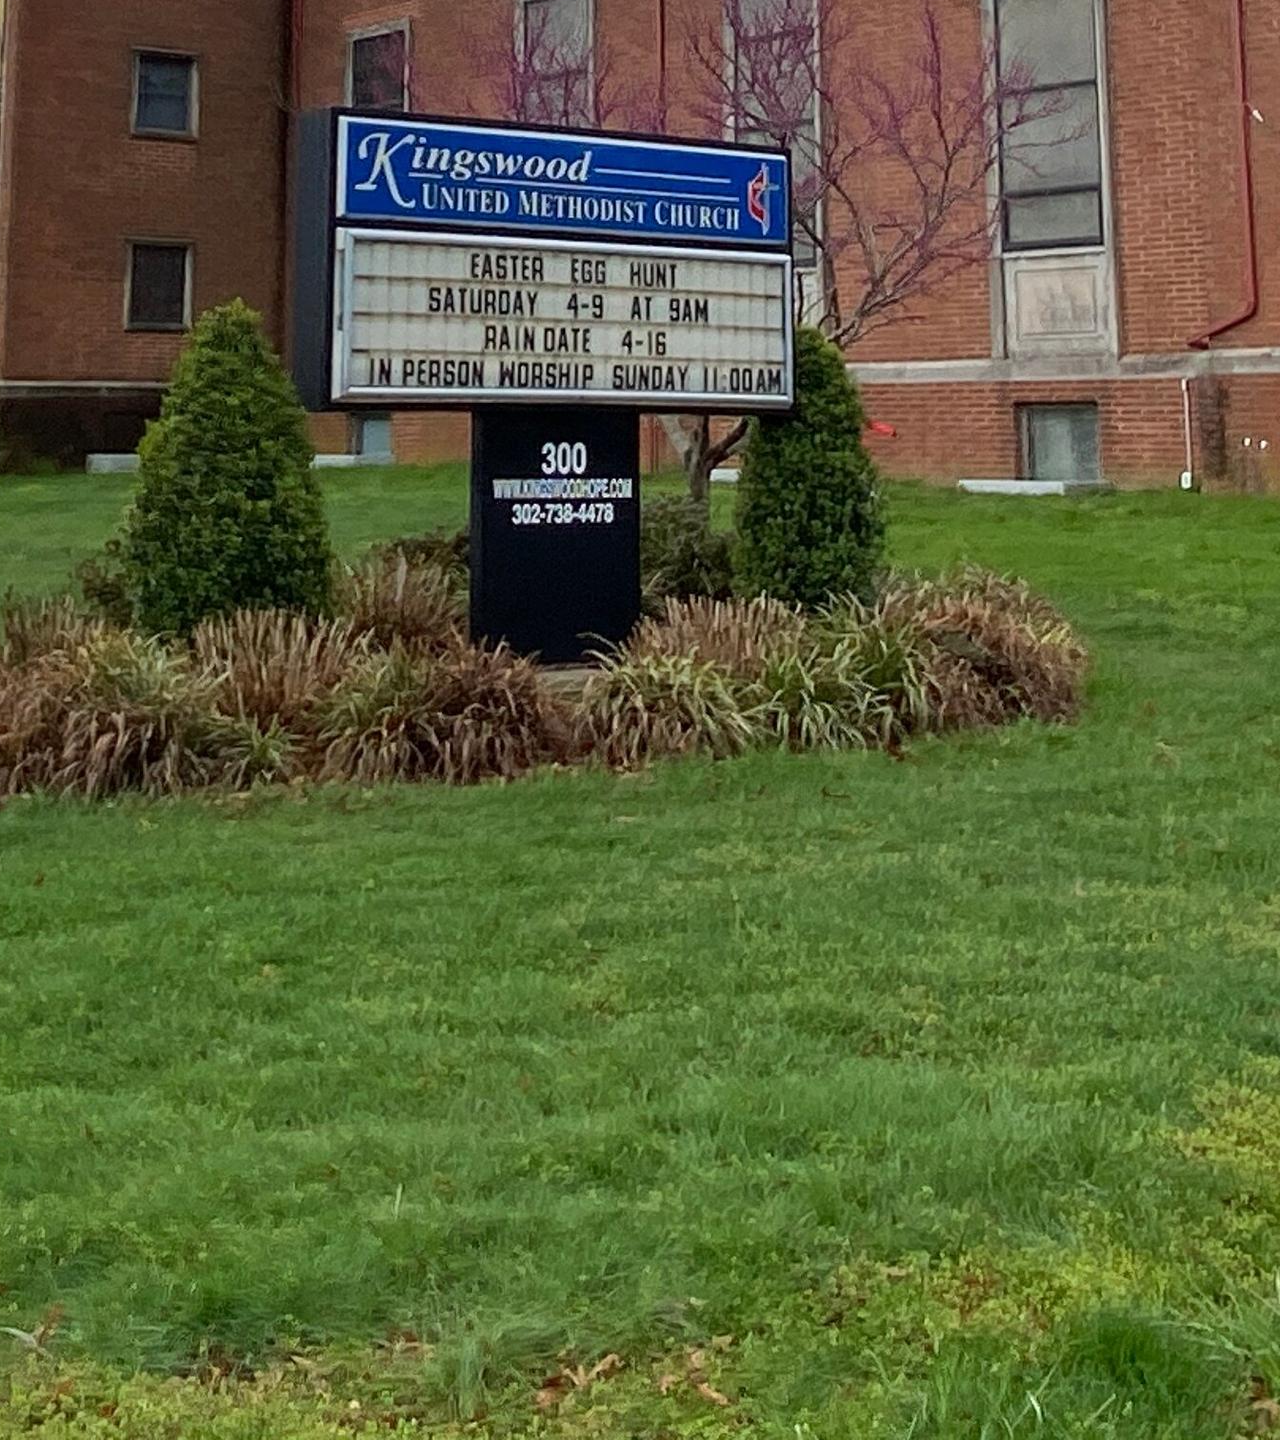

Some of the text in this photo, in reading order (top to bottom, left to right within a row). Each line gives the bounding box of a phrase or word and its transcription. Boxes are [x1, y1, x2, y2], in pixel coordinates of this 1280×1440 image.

[354, 132, 592, 208] Kingswood
[422, 183, 740, 230] UNITED METHODIST CHURCH
[471, 253, 677, 288] EASTER EGG HUNT
[428, 287, 709, 323] SATURDAY 4-9 AT 9AM
[484, 325, 667, 356] RAIN DATE 4-16
[370, 358, 391, 385] IN
[402, 359, 484, 387] PERSON
[499, 361, 594, 389] WORSHIP
[612, 364, 688, 391] SUNDAY
[541, 442, 587, 475] 300
